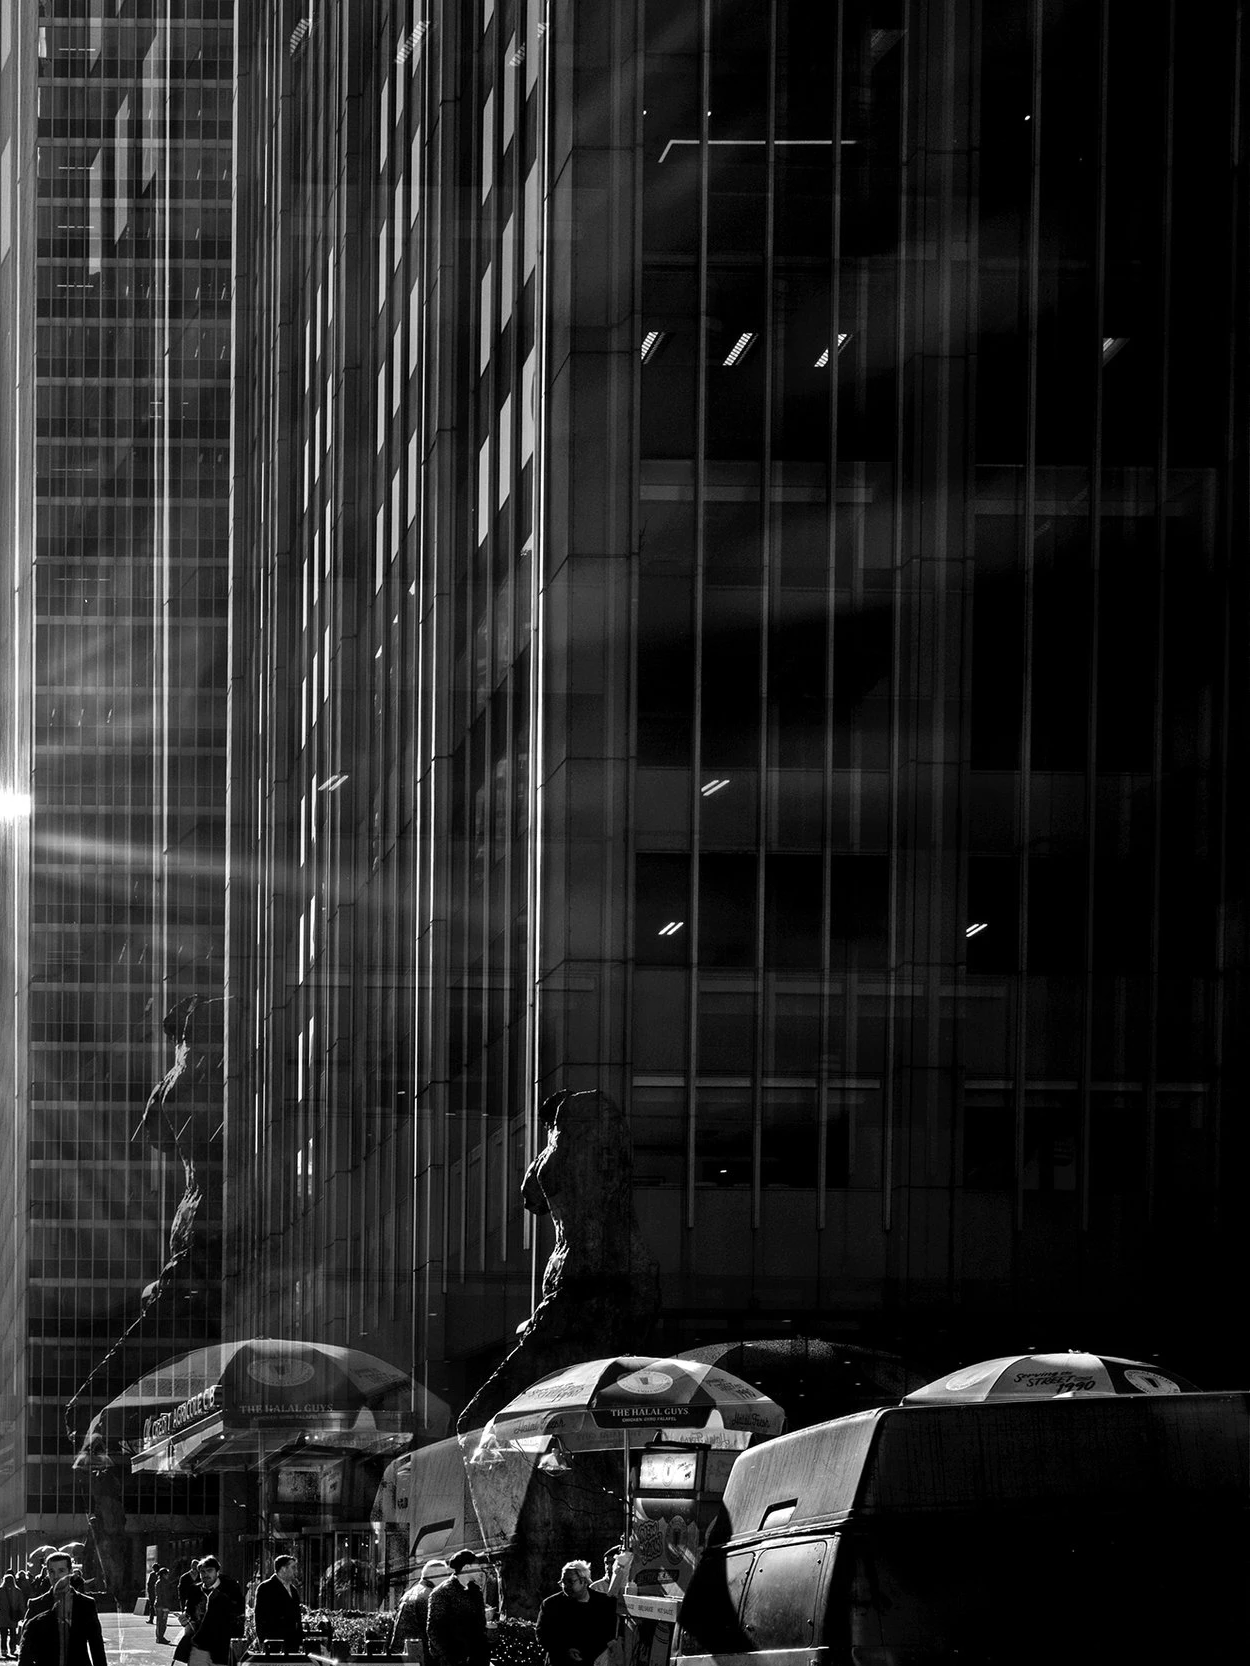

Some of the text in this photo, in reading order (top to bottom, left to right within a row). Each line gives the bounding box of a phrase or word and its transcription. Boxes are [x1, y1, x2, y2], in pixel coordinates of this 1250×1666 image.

[1026, 1375, 1076, 1387] STREET
[1056, 1380, 1096, 1395] 1990
[239, 1403, 333, 1414] THE HALAL GUYS
[610, 1407, 689, 1417] THE HALAL GUYS
